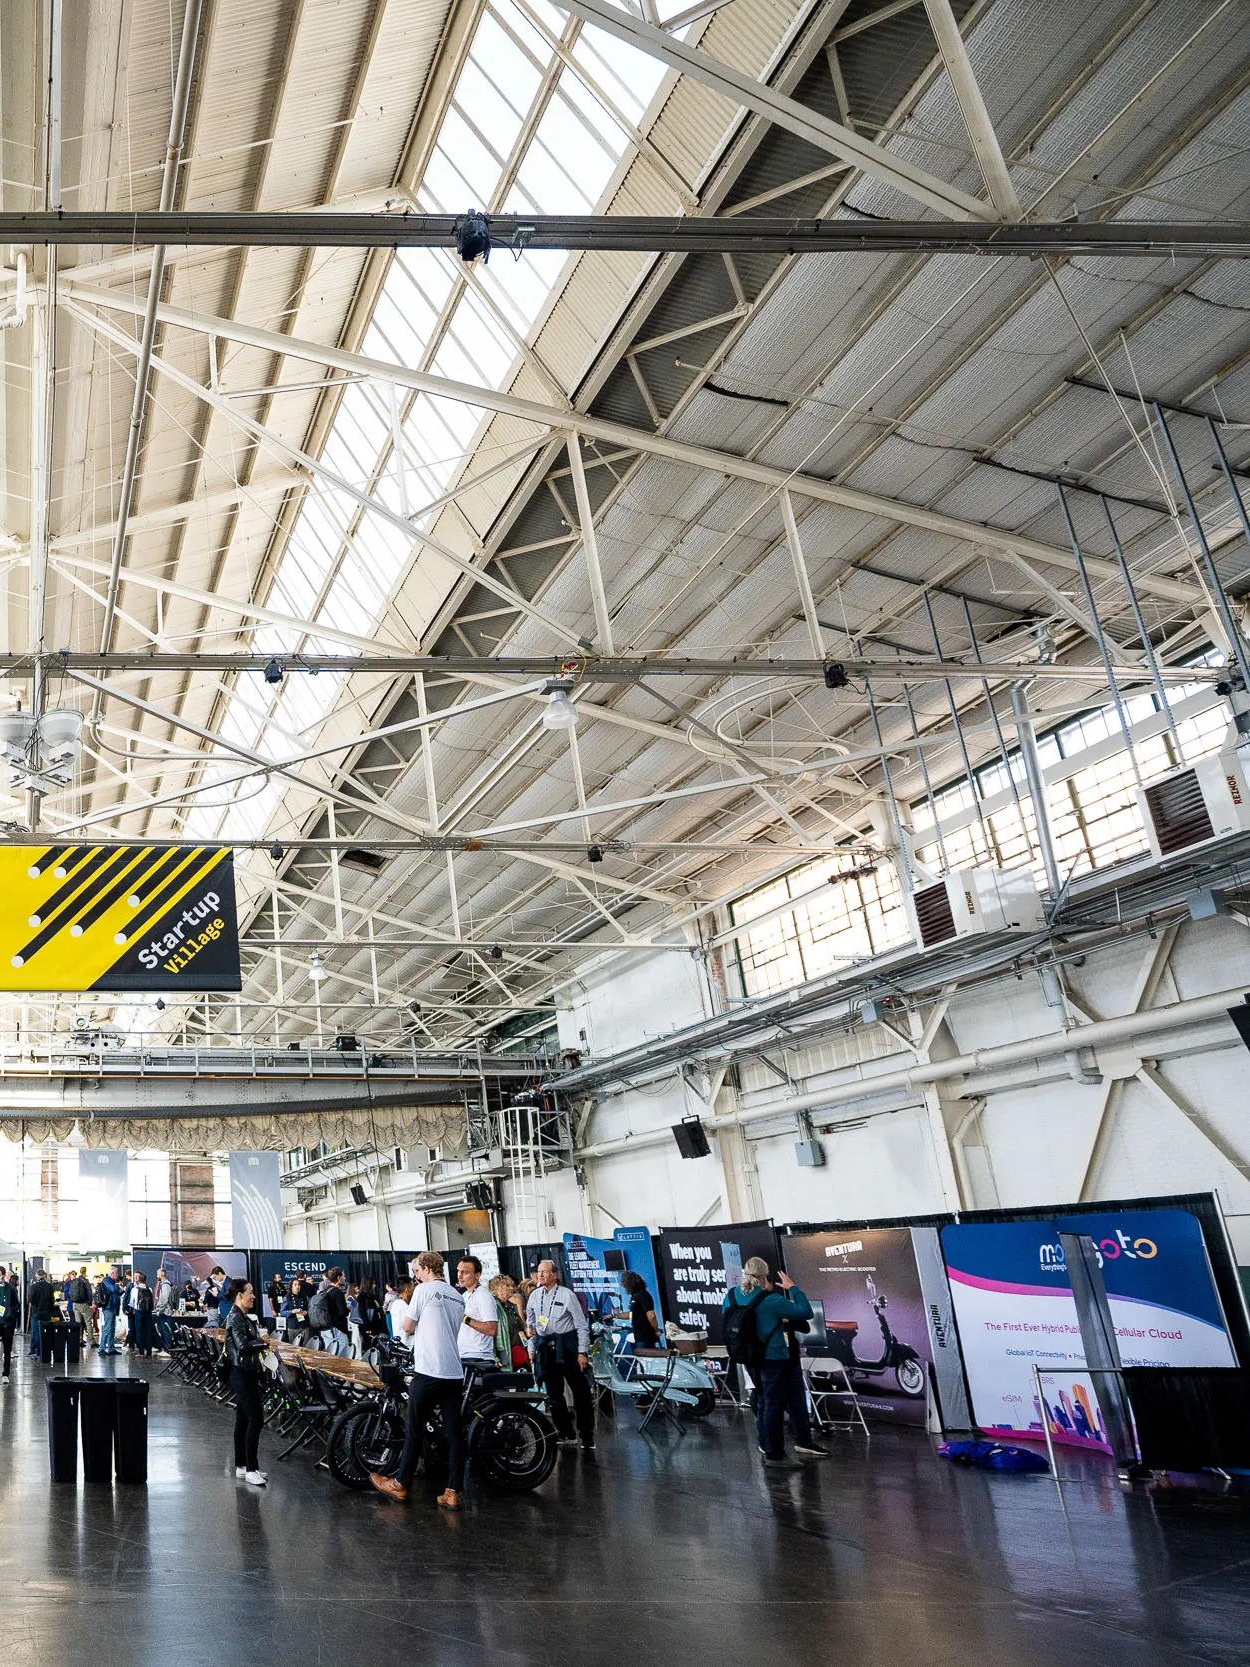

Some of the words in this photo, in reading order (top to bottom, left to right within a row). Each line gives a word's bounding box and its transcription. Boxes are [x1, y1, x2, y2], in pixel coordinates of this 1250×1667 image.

[1226, 775, 1242, 805] REZNOR
[965, 891, 975, 915] REZNOR
[138, 891, 220, 969] Startup
[163, 918, 225, 974] Village
[669, 1243, 695, 1260] When
[693, 1246, 712, 1263] you
[825, 1240, 863, 1257] AVENTURA
[285, 1262, 326, 1271] ESCEND
[673, 1268, 688, 1281] are
[687, 1264, 710, 1285] truly
[676, 1286, 703, 1305] about
[679, 1309, 710, 1331] safety.
[930, 1304, 947, 1349] AVENTURA
[984, 1323, 1001, 1331] The
[1003, 1323, 1022, 1331] First
[1024, 1324, 1040, 1332] Ever
[1042, 1324, 1064, 1334] Hybrid
[1148, 1329, 1183, 1340] Cloud
[1035, 1350, 1068, 1360] Connectivity
[1002, 1395, 1022, 1403] eSIM
